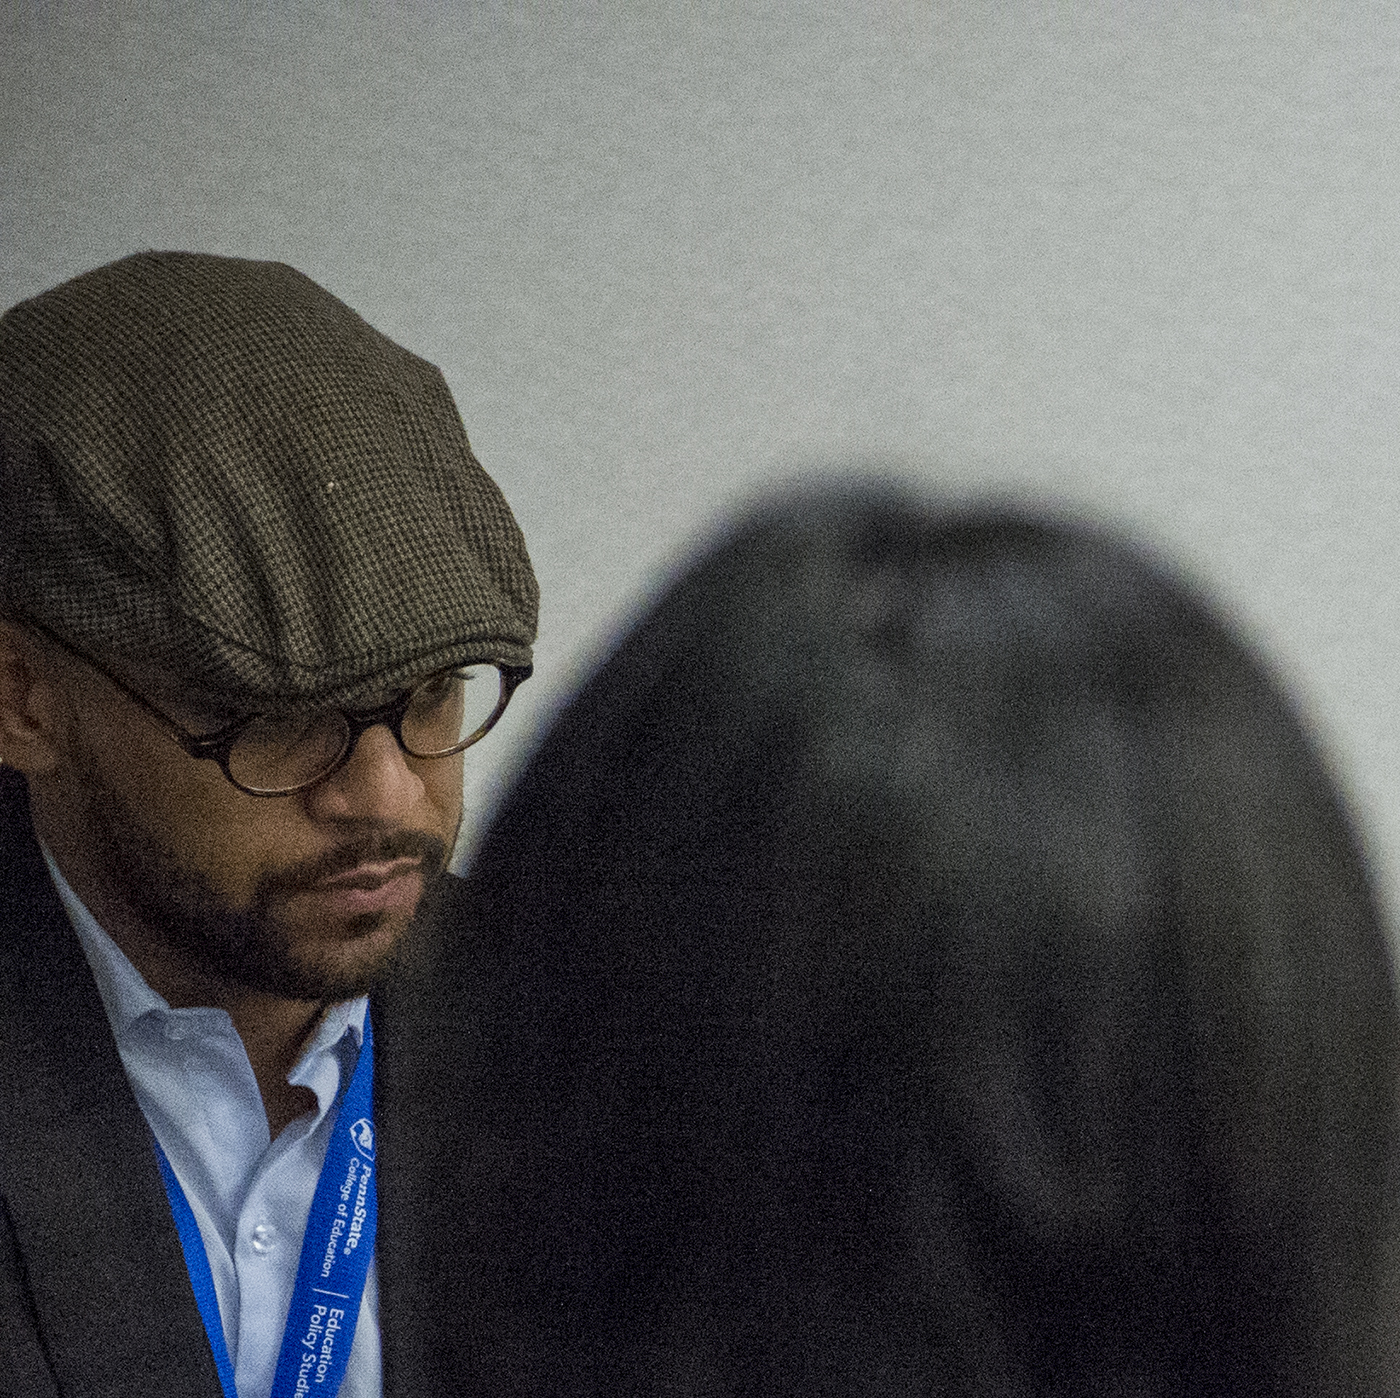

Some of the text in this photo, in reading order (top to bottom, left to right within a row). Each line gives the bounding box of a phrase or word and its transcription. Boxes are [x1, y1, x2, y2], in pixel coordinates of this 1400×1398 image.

[321, 1157, 360, 1278] College of Education
[301, 1304, 328, 1350] Policy
[315, 1308, 345, 1383] Education
